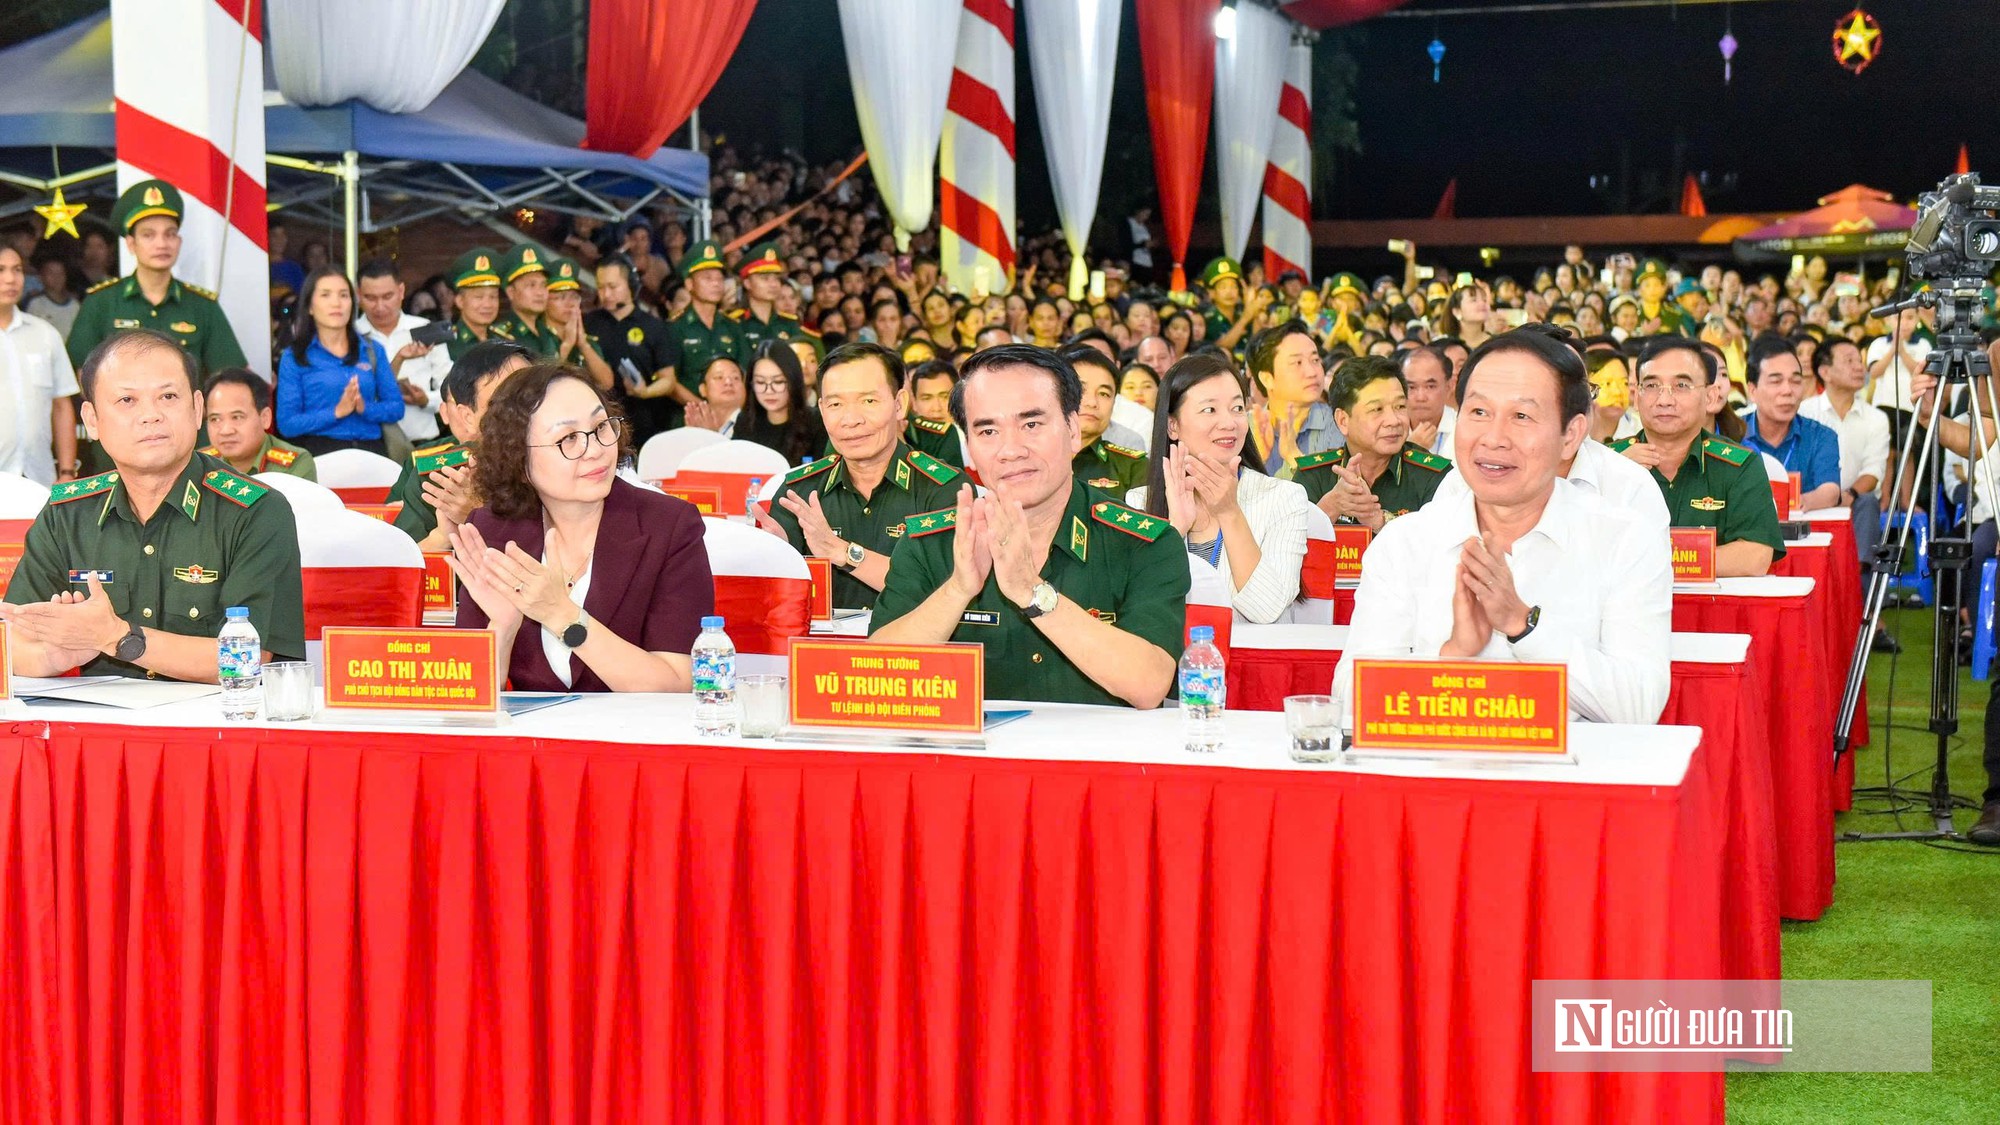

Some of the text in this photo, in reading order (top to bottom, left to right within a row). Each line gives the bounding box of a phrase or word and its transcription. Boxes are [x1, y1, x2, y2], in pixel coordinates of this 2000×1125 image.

[415, 641, 431, 654] CHÍ
[348, 658, 472, 683] CAO THỊ XUÂN
[851, 657, 920, 670] TRUNG TƯỚNG
[815, 672, 957, 699] VŨ TRUNG KIÊN
[831, 701, 842, 713] TƯ
[842, 700, 863, 715] LỆNH
[864, 701, 875, 716] BỘ
[892, 702, 911, 716] BIÊN
[913, 703, 940, 717] PHÒNG
[1385, 690, 1535, 719] LÊ TIẾN CHÂU
